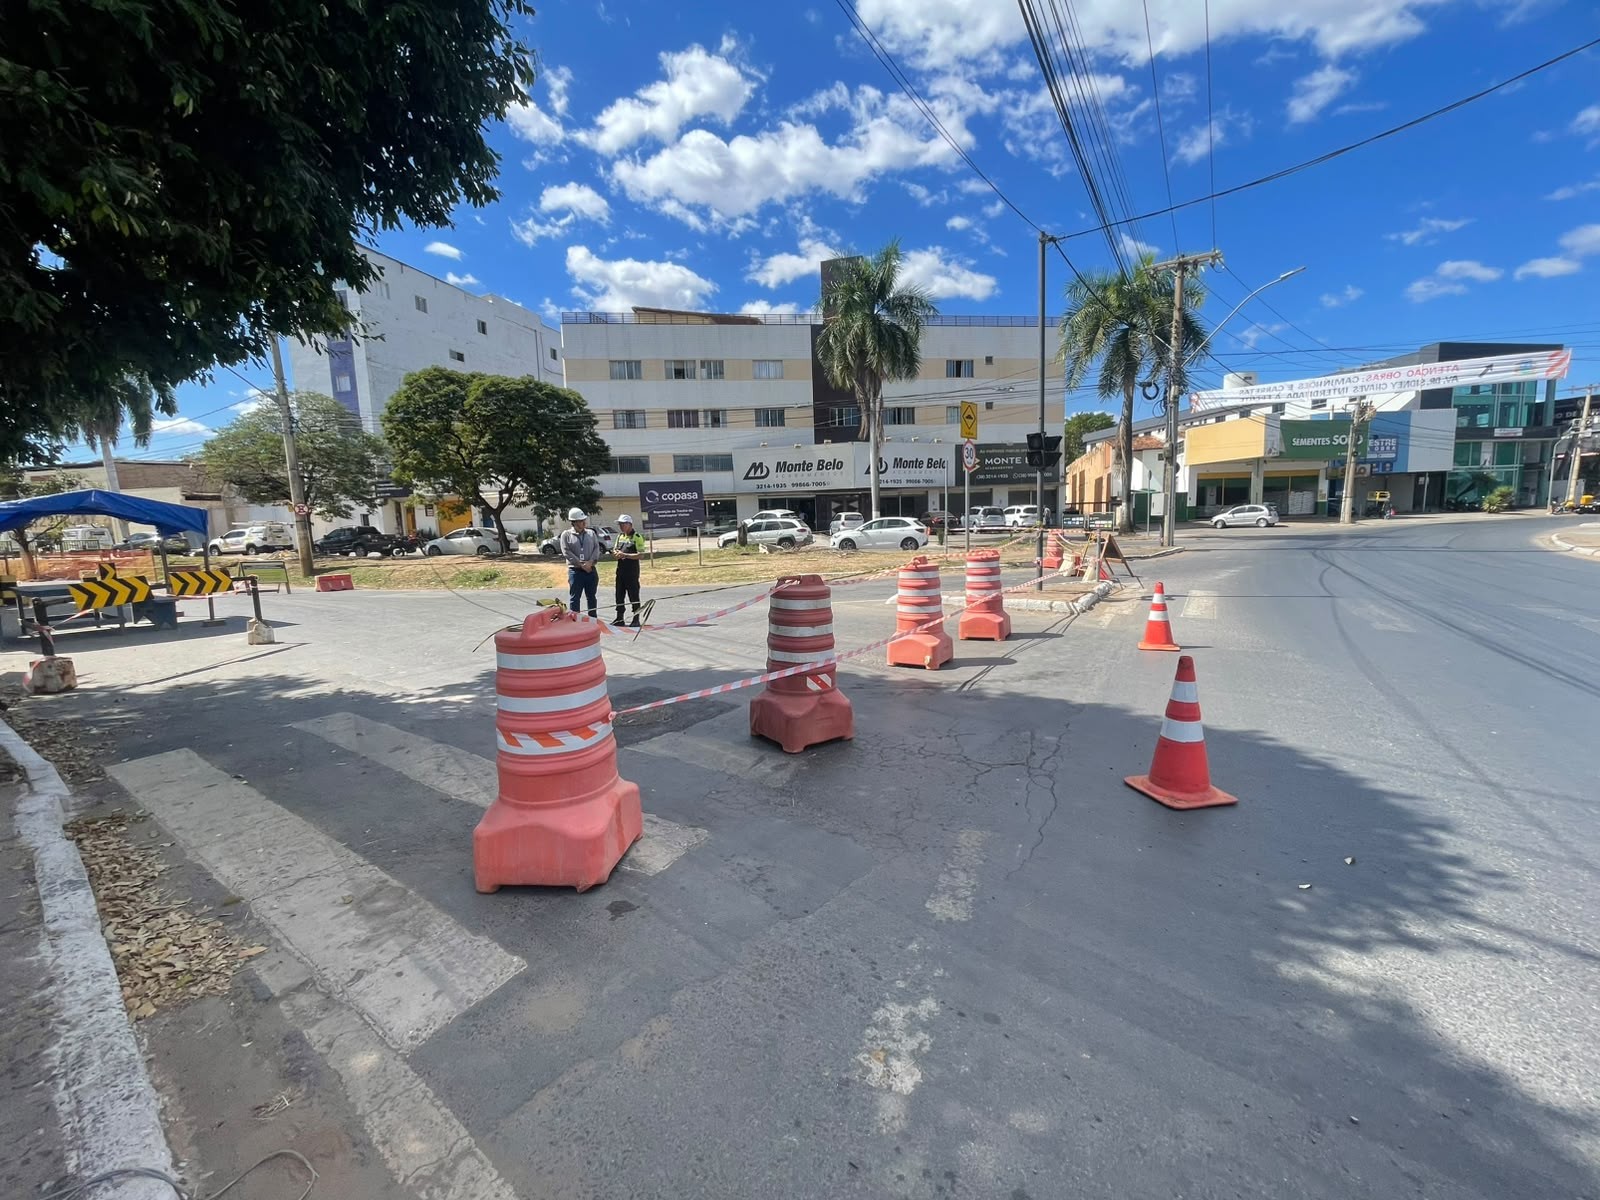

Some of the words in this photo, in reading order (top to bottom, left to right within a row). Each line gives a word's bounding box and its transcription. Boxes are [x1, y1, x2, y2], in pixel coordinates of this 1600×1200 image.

[1291, 437, 1330, 446] SEMENTES
[1332, 435, 1364, 446] SOO
[1369, 438, 1397, 446] ESTRE
[964, 447, 974, 460] 30
[775, 460, 814, 473] Monte
[816, 458, 844, 471] Belo
[892, 457, 924, 469] Monte
[984, 456, 1022, 465] MONTE
[661, 491, 699, 503] copasa
